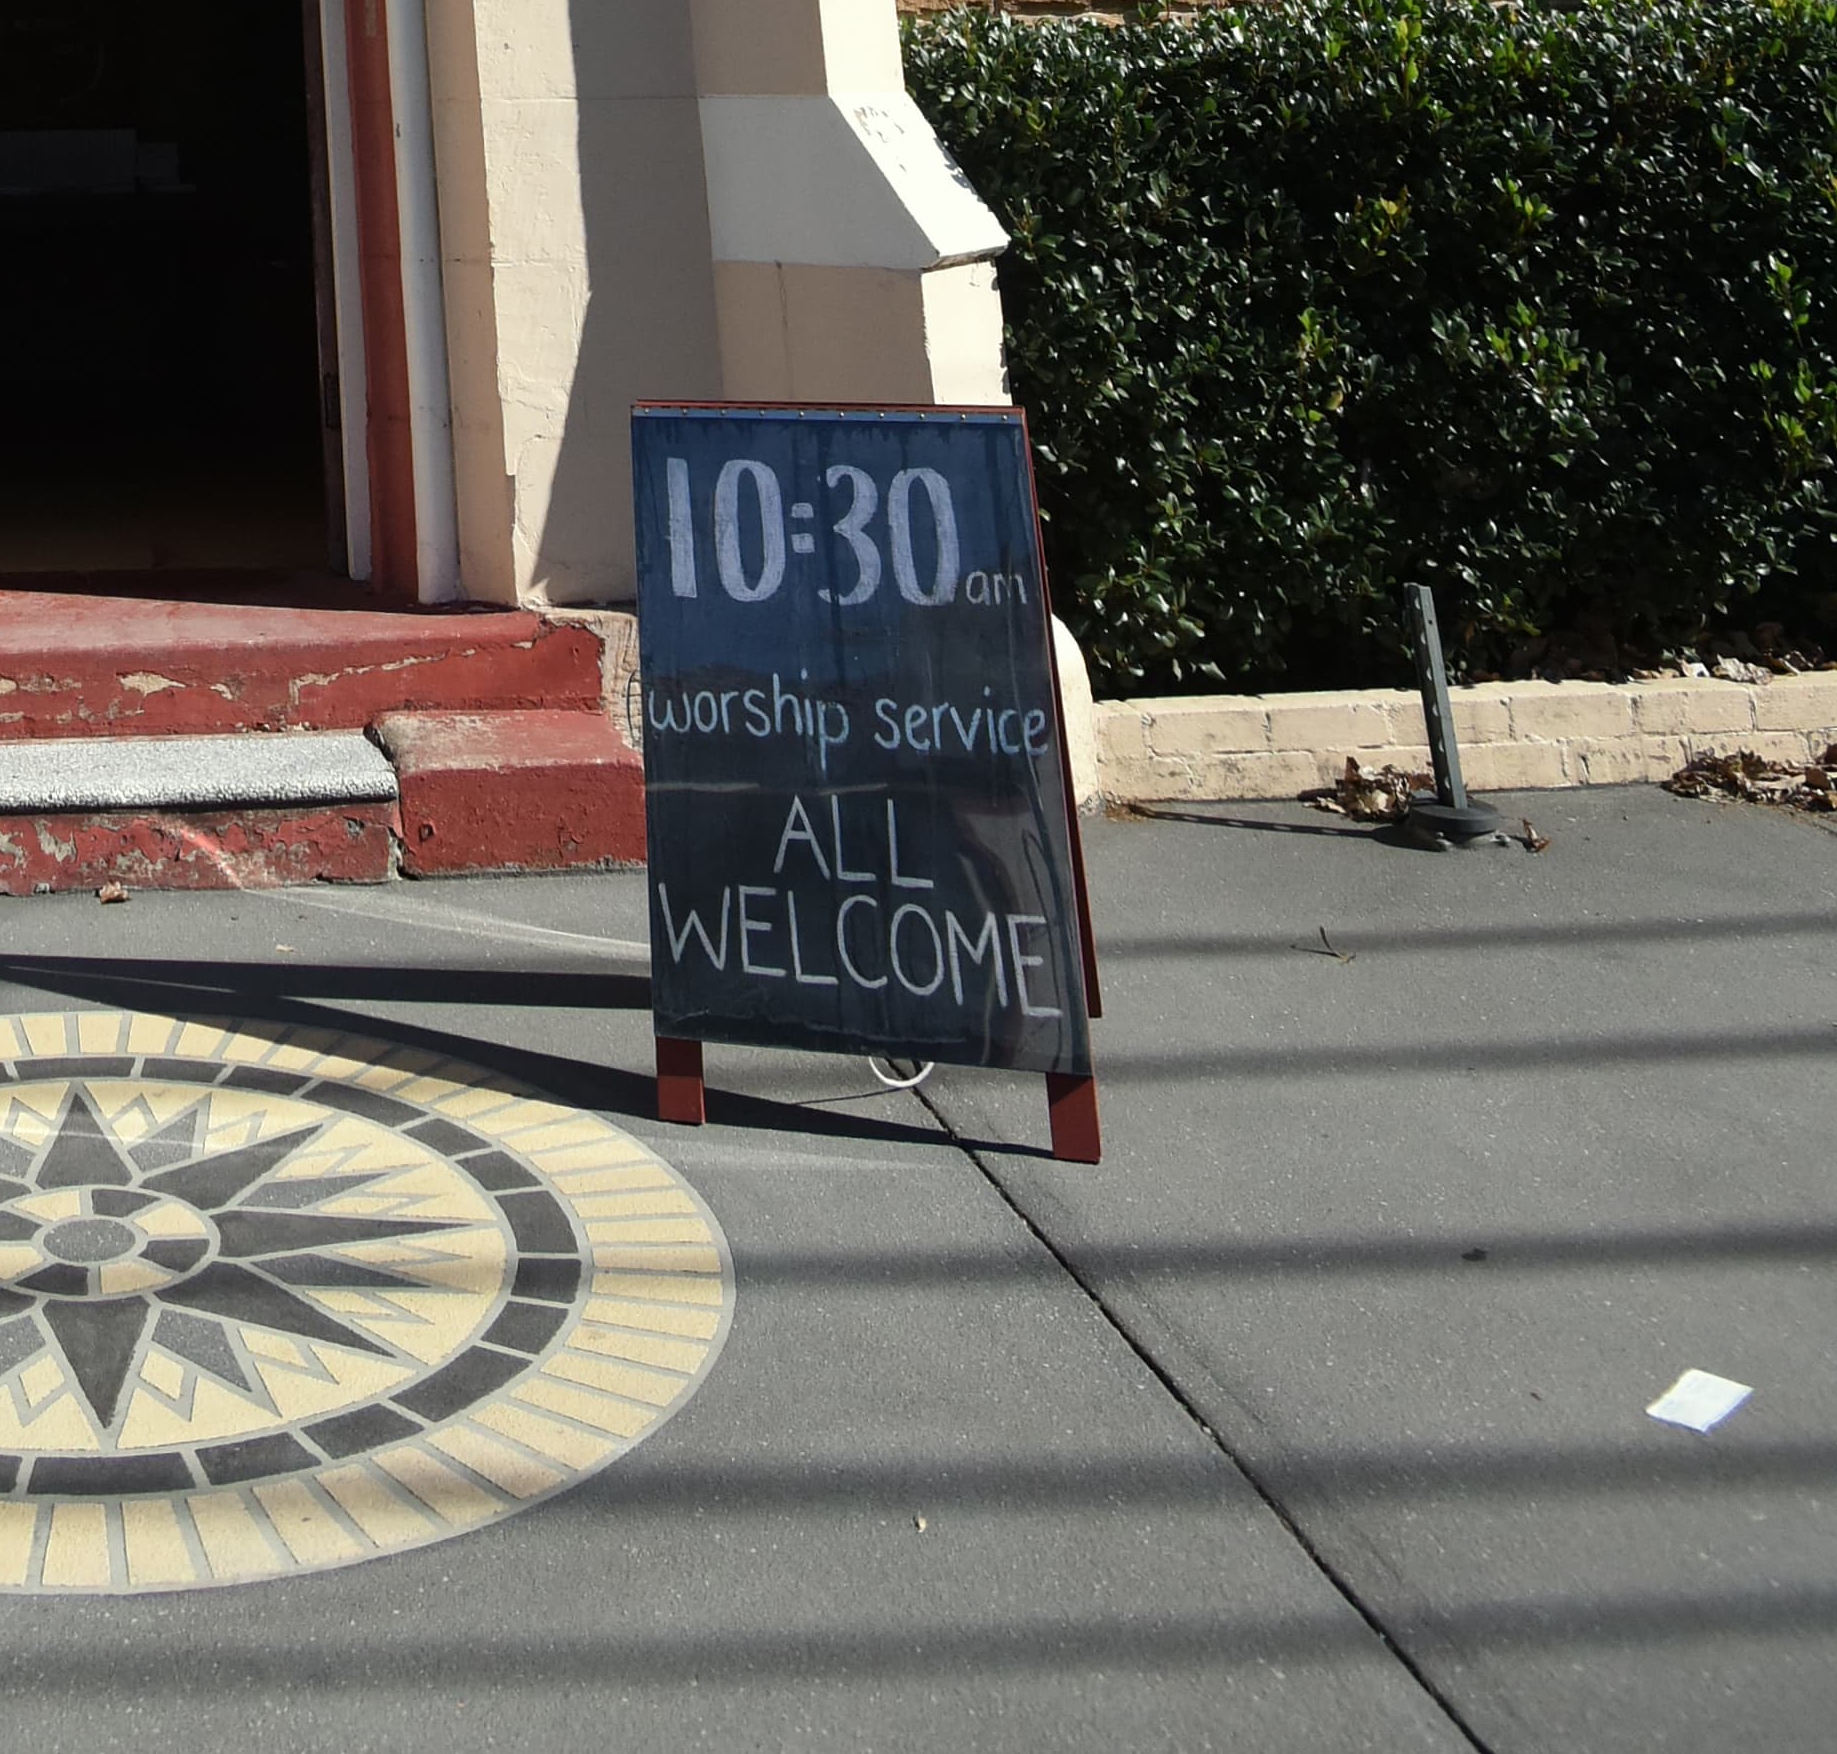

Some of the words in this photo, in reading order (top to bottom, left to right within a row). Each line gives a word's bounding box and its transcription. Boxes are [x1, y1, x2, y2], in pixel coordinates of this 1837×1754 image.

[647, 668, 850, 771] worship
[874, 685, 1049, 759] service
[773, 793, 935, 890] ALL
[658, 882, 1063, 1018] WELCOME
